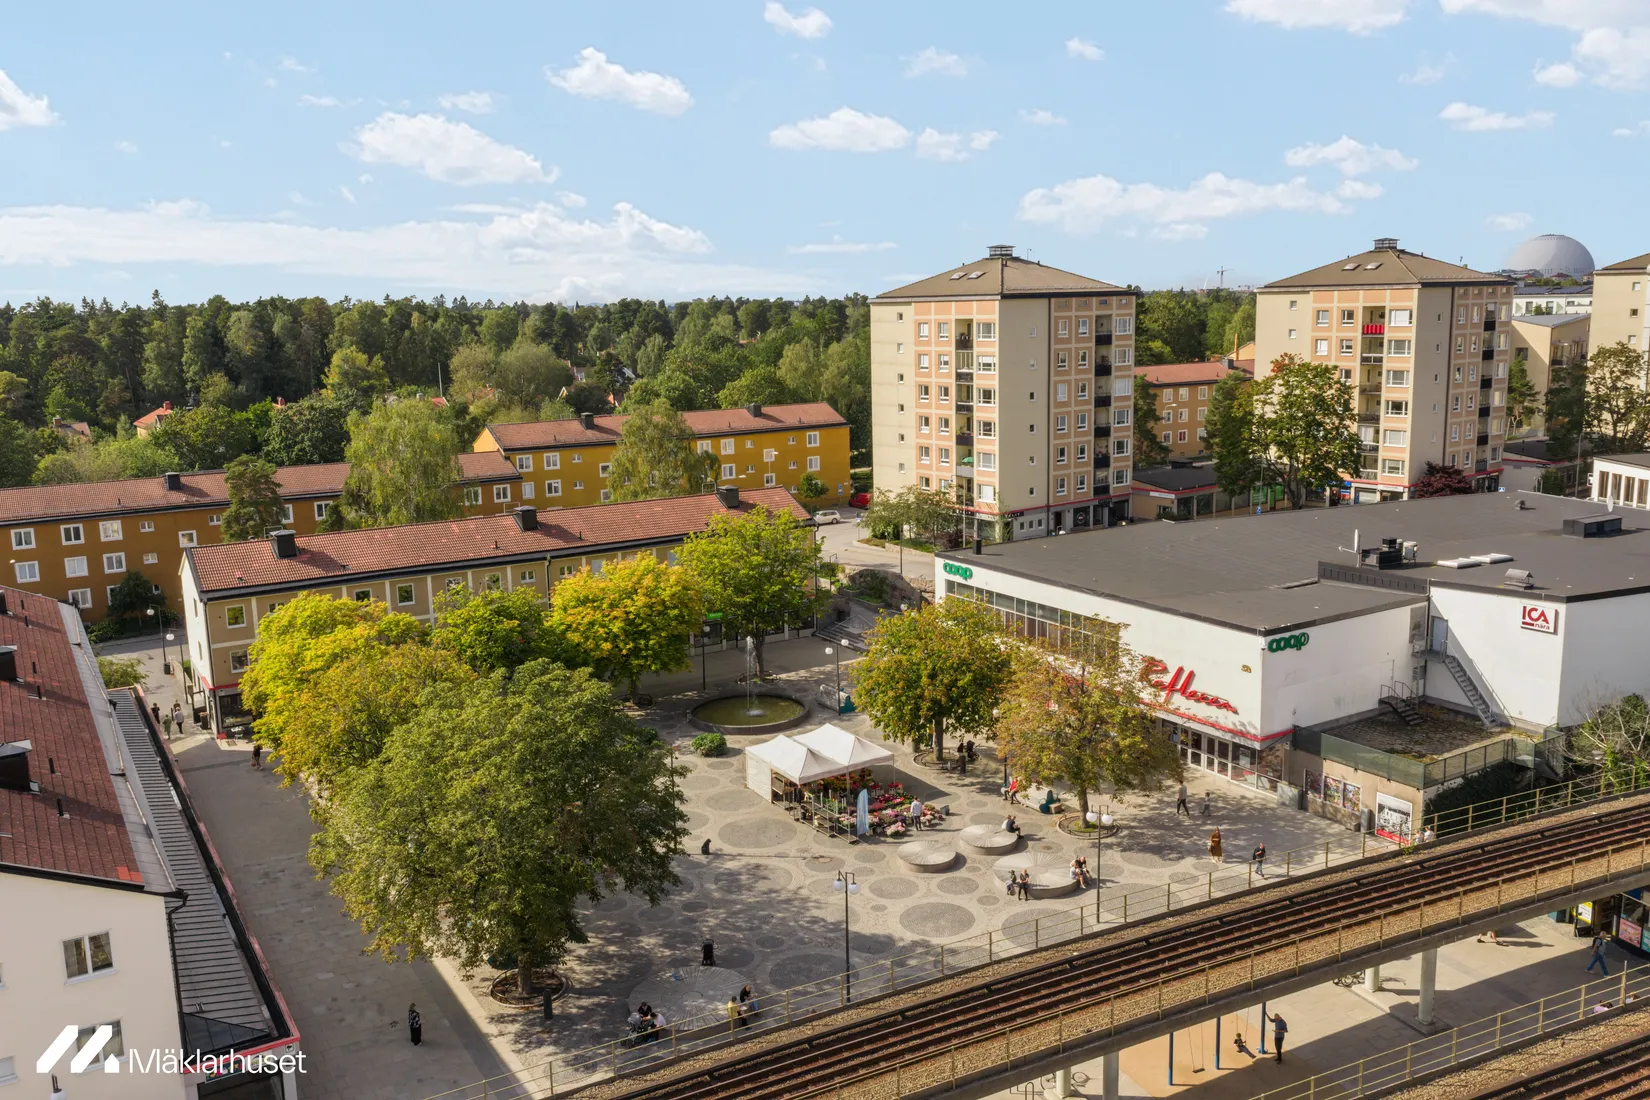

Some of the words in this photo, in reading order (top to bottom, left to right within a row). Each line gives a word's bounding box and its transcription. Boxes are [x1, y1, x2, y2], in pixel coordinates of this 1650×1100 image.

[943, 562, 973, 580] coop
[1522, 605, 1550, 625] ICA
[1267, 632, 1310, 653] coop
